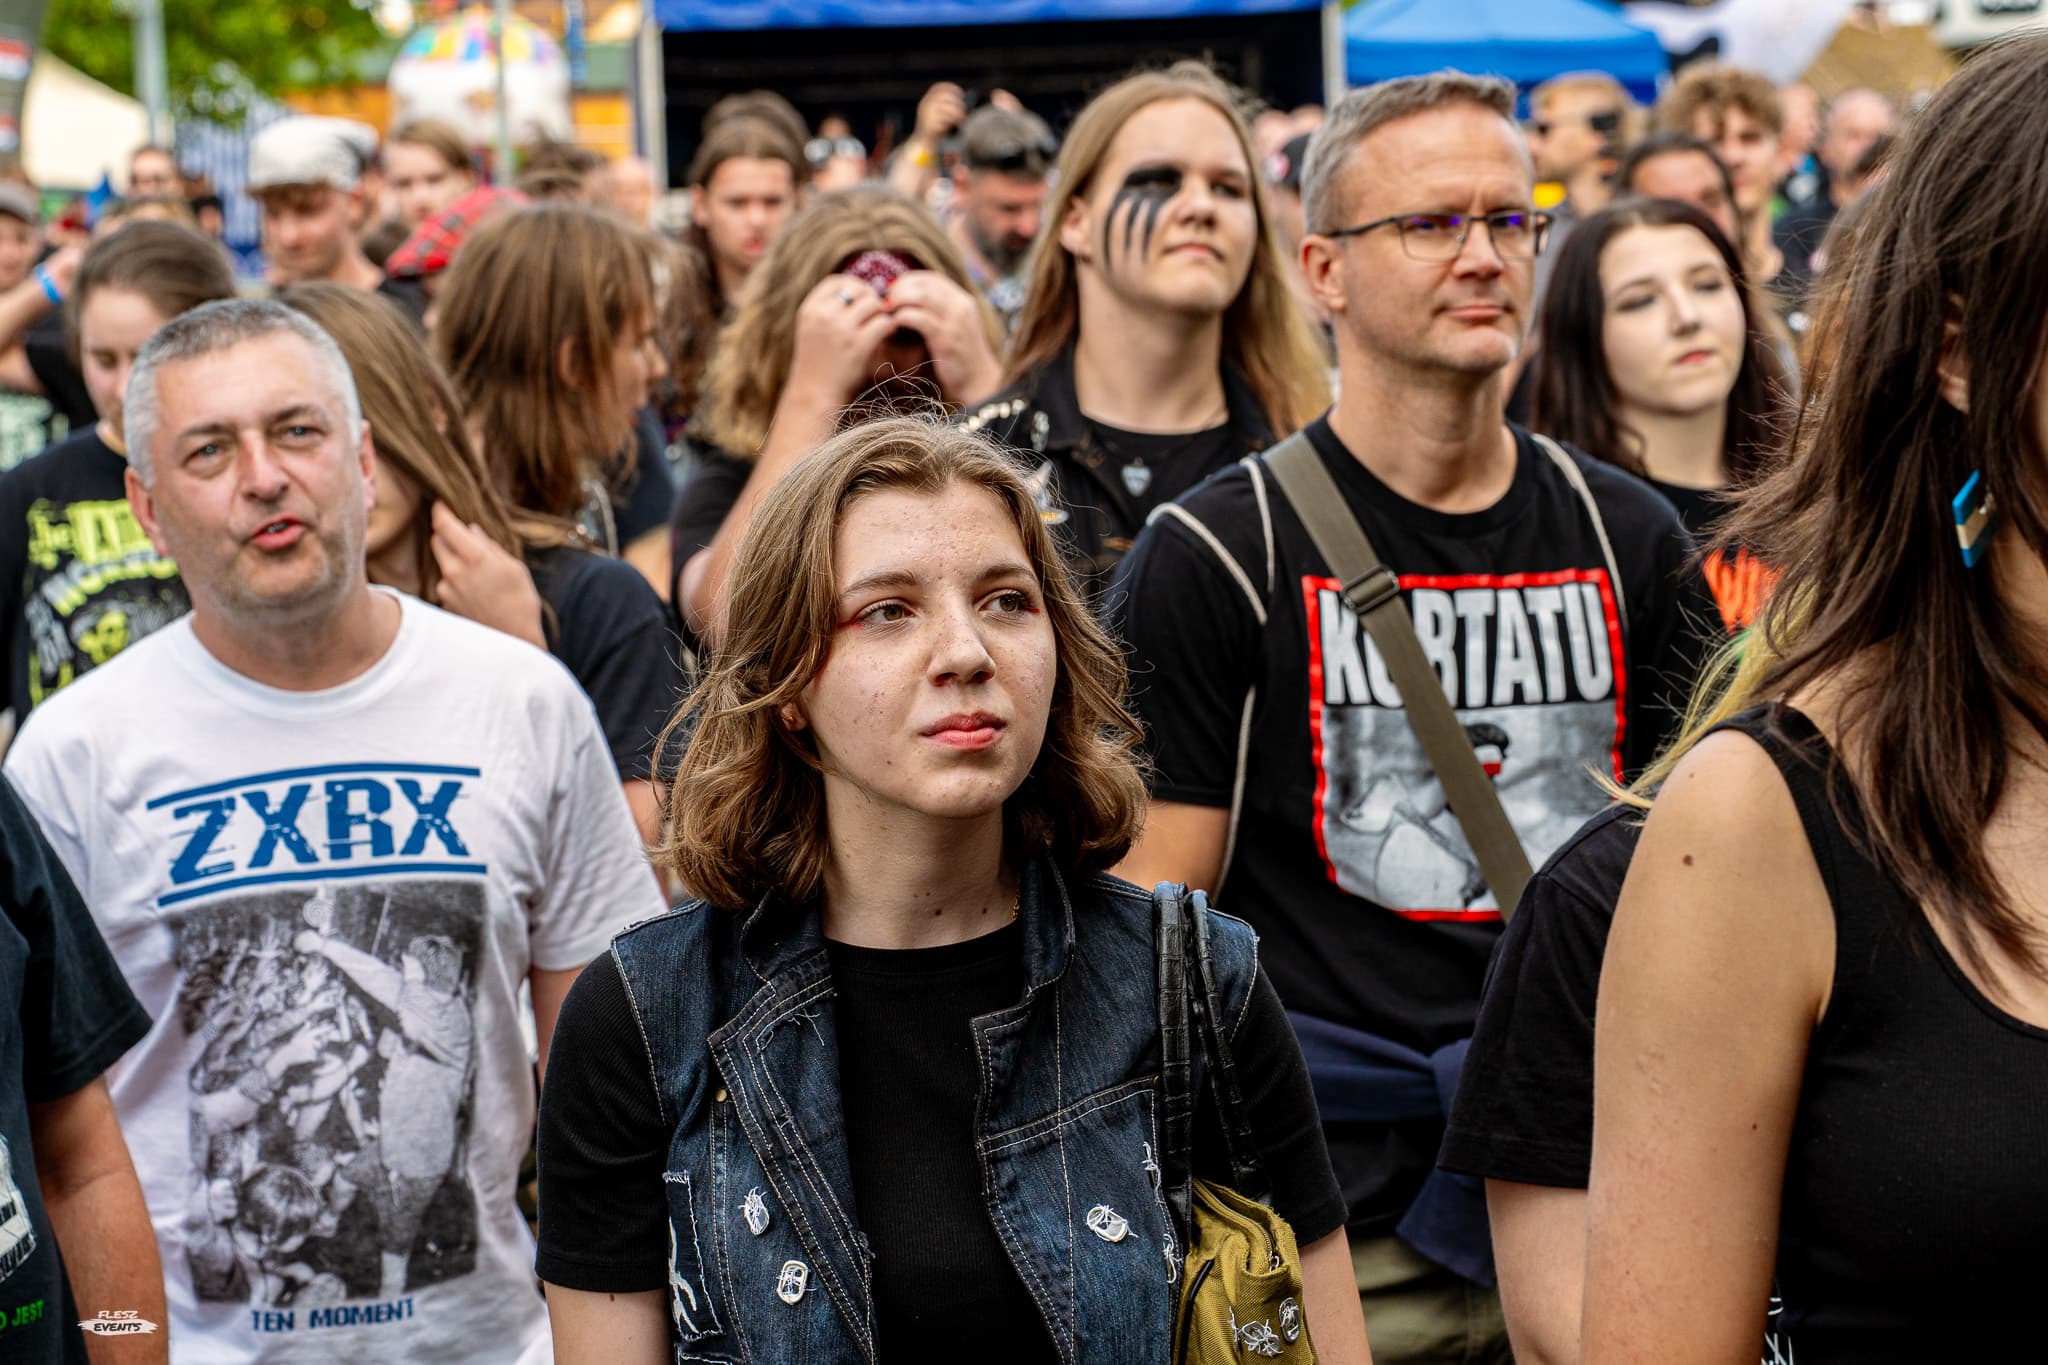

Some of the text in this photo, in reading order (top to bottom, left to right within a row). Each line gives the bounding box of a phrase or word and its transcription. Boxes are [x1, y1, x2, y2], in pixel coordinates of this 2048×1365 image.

[169, 778, 470, 884] ZXRX
[12, 1300, 44, 1327] JEST
[252, 1297, 413, 1332] TEN MOMENT
